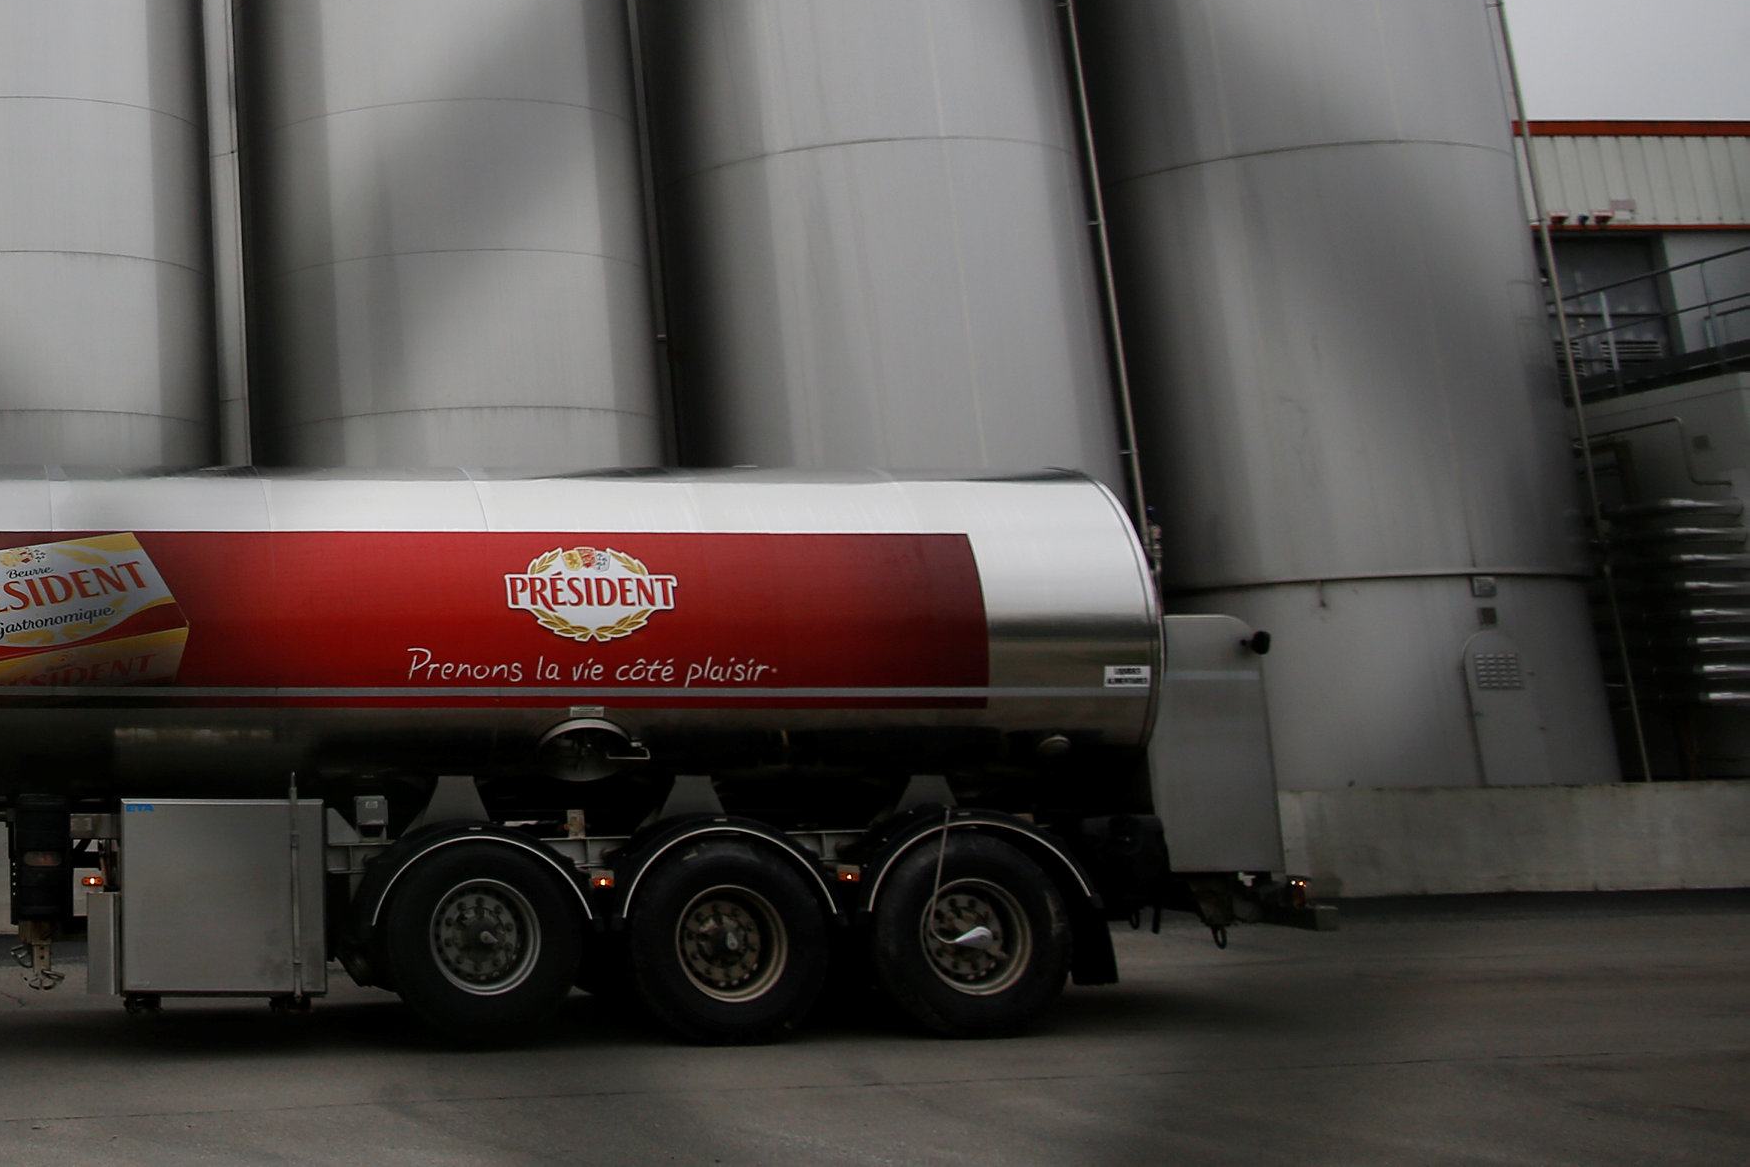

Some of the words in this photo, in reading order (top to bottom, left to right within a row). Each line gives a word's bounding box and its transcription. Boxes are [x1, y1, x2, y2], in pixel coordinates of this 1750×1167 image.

[5, 564, 54, 580] Beurre
[508, 572, 676, 612] PRÉSIDENT
[406, 647, 523, 682] Prenons
[536, 655, 562, 681] la
[572, 658, 604, 681] vie
[615, 658, 675, 682] côté
[683, 656, 770, 689] plaisir
